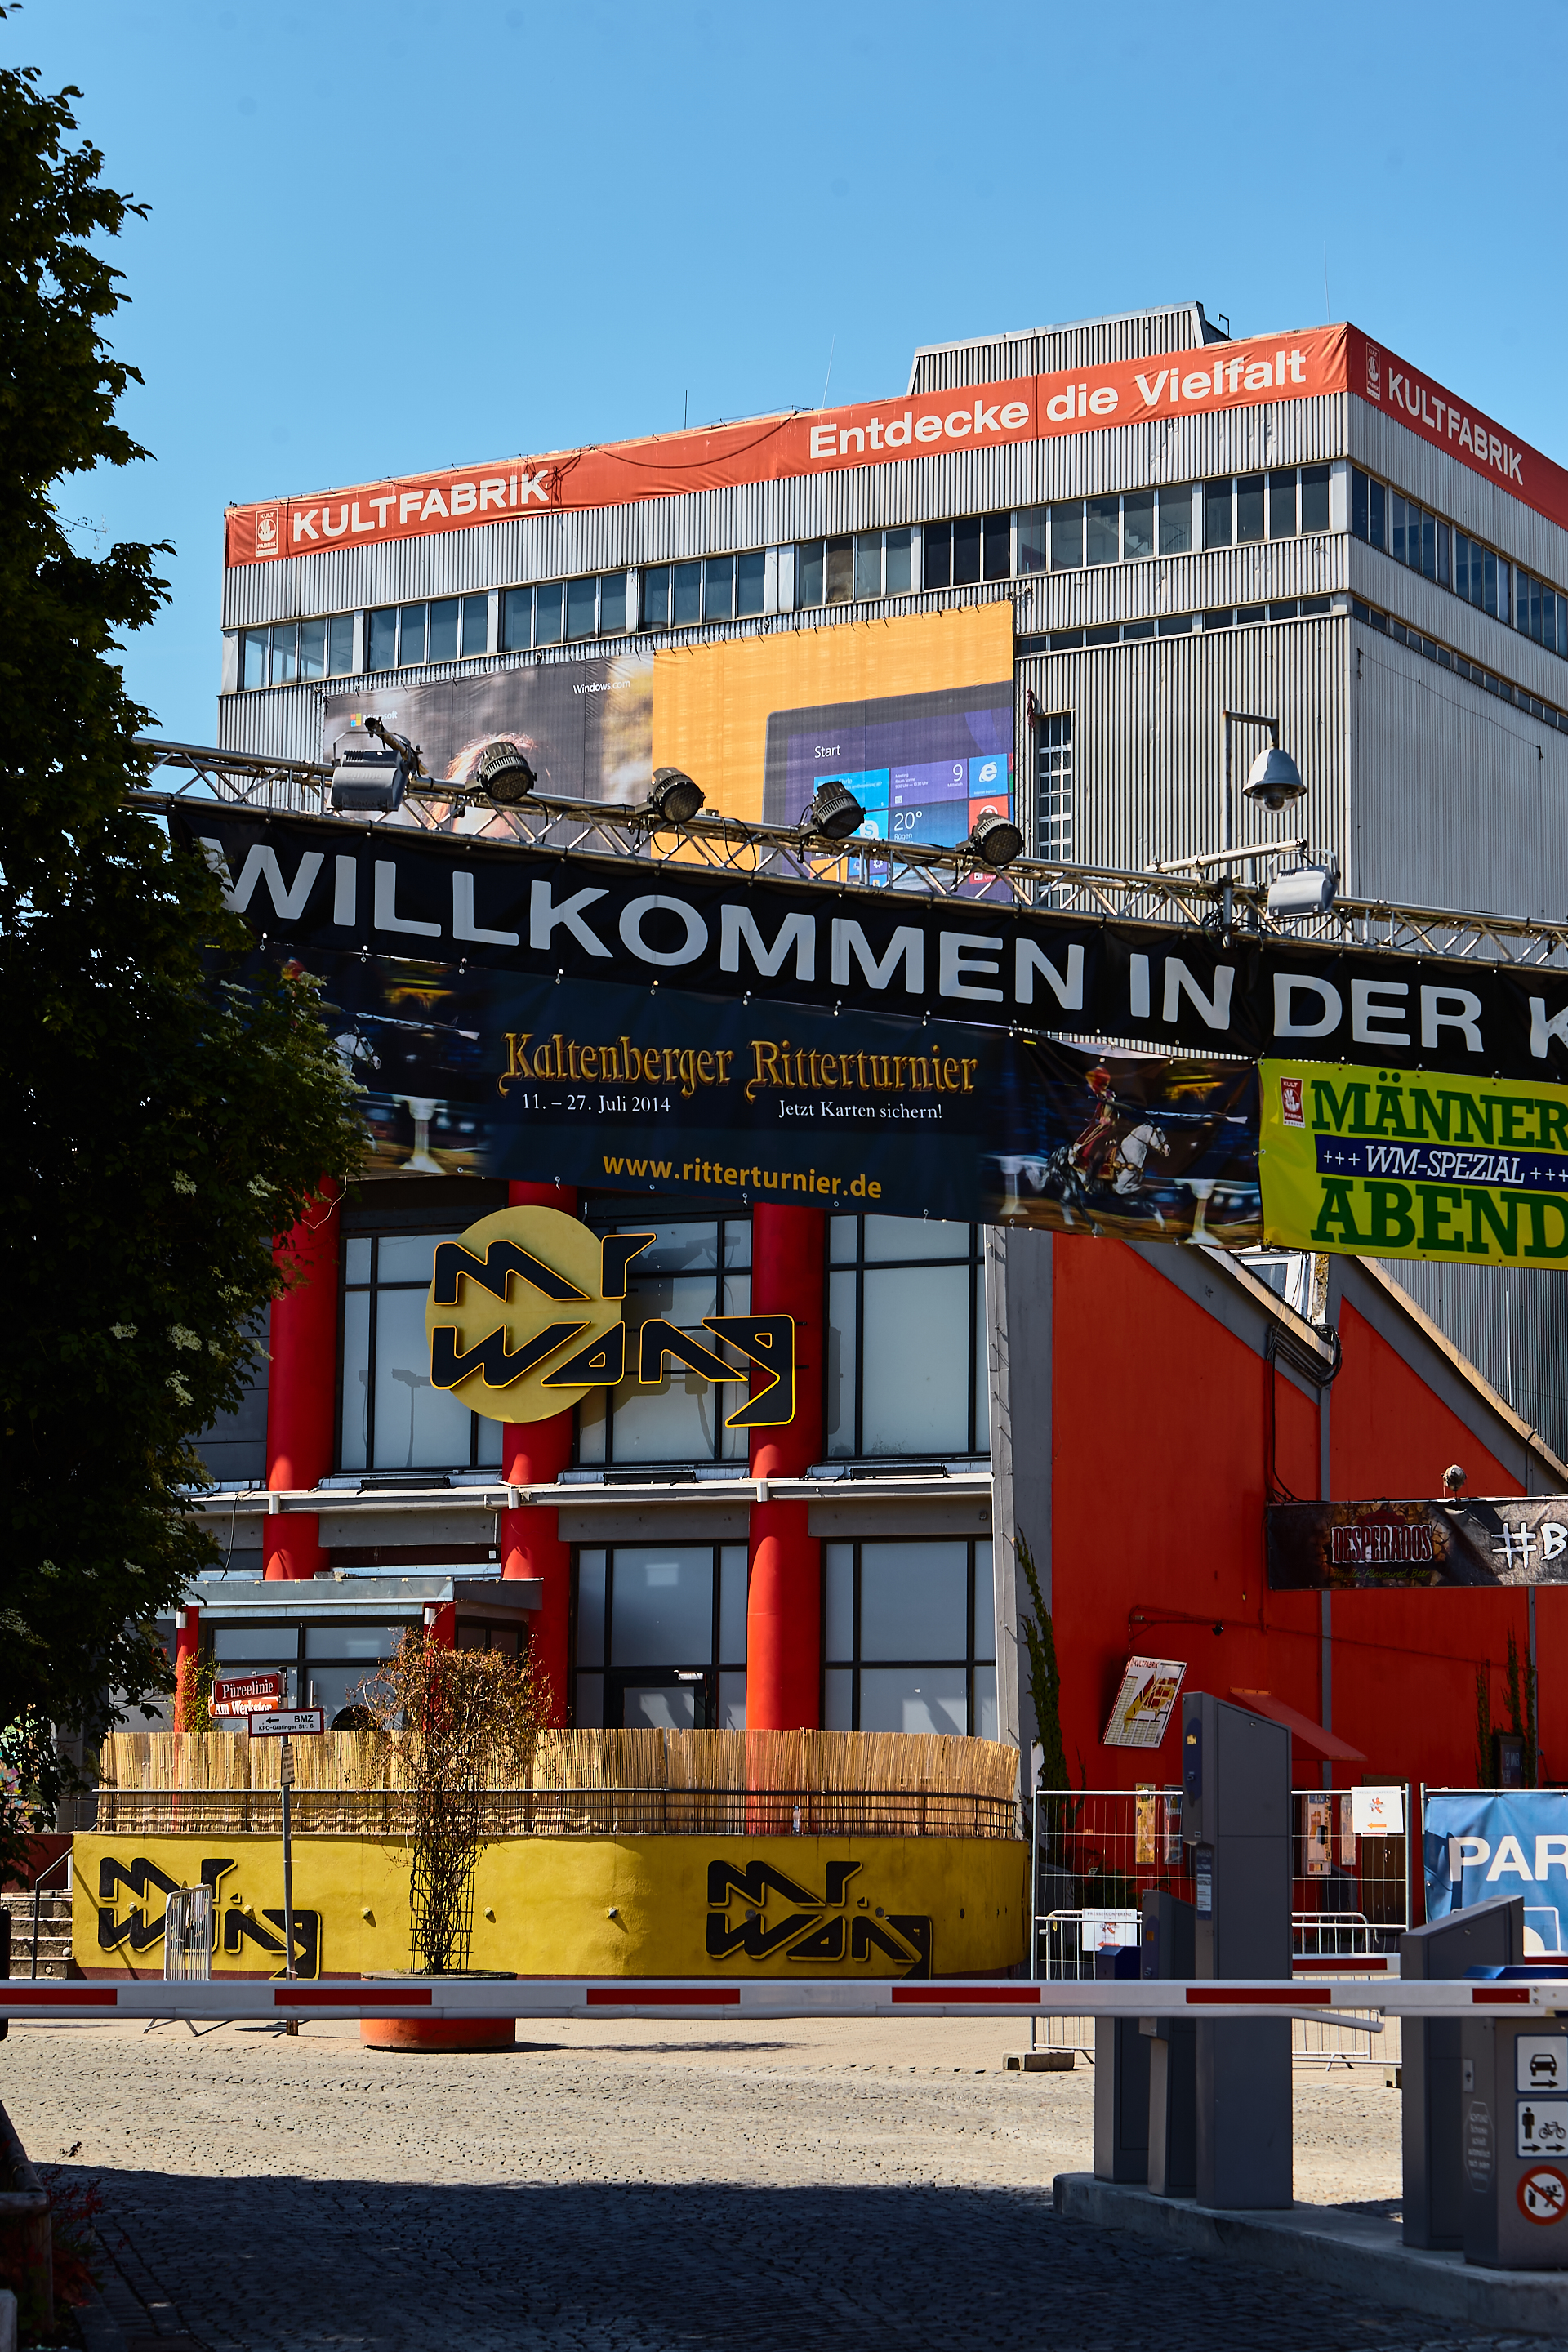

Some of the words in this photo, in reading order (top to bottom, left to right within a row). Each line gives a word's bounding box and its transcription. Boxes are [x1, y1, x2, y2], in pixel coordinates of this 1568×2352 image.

[809, 399, 1030, 459] Entdecke
[1046, 382, 1119, 422] die
[1134, 349, 1307, 407] Vielfalt
[1388, 367, 1524, 486] KULTFABRIK
[292, 469, 550, 543] KULTFABRIK
[572, 679, 631, 695] Windows.com
[814, 744, 841, 759] Start
[952, 764, 963, 782] 9
[893, 810, 923, 831] 20°
[894, 832, 913, 841] Rügen
[199, 836, 1085, 1011] WILLKOMMEN
[1129, 953, 1236, 1031] IN
[1272, 973, 1485, 1053] DER
[497, 1032, 734, 1099] Kaltenberger
[744, 1039, 979, 1104] Ritterturnier
[522, 1094, 547, 1110] 11.
[566, 1095, 592, 1111] 27.
[597, 1094, 628, 1113] Juli
[631, 1096, 671, 1113] 2014
[777, 1099, 815, 1119] Jetzt
[820, 1101, 876, 1119] Karten
[880, 1102, 942, 1120] sichern!
[1310, 1071, 1568, 1151] MÄNNER
[602, 1155, 882, 1199] www.ritterturnier.de
[1365, 1145, 1526, 1184] WM-SPEZIAL
[1310, 1177, 1568, 1258] ABEND
[1331, 1525, 1433, 1564] DESPERADOS
[1410, 1568, 1431, 1579] Beer
[222, 1678, 274, 1699] Püreelinie
[214, 1703, 230, 1715] Am
[294, 1714, 314, 1723] BMZ
[1448, 1835, 1568, 1882] PAR
